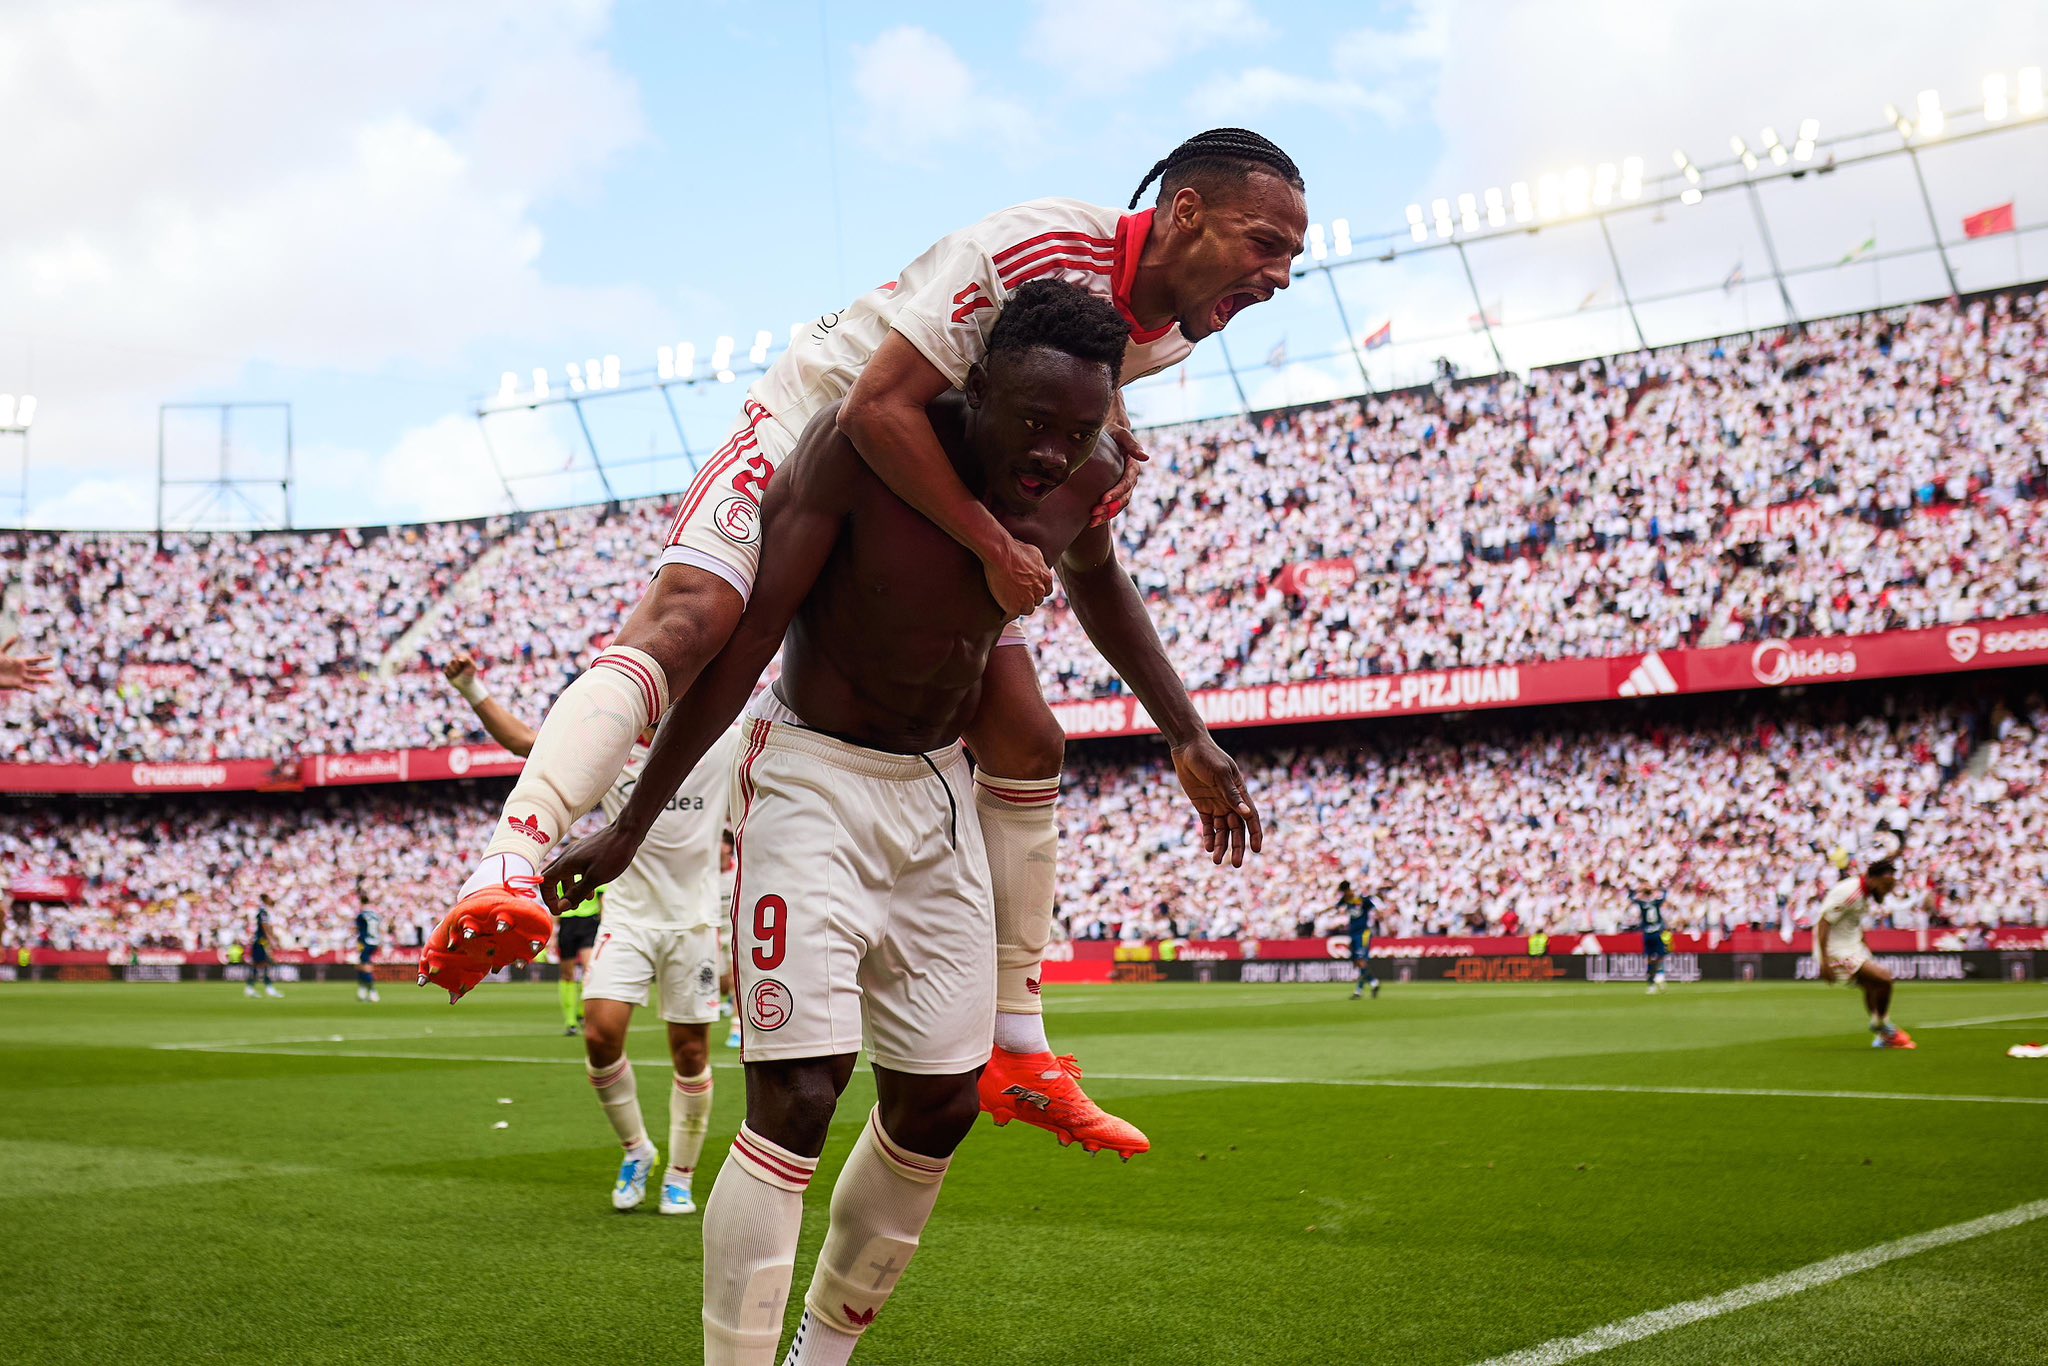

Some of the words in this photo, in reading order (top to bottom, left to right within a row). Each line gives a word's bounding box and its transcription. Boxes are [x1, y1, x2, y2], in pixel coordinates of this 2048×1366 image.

[1193, 686, 1267, 724] AMON
[1268, 668, 1520, 720] SANCHEZ-PIZJUAN
[132, 763, 227, 787] Cruzcampo
[664, 794, 704, 811] dea
[751, 893, 788, 972] 9
